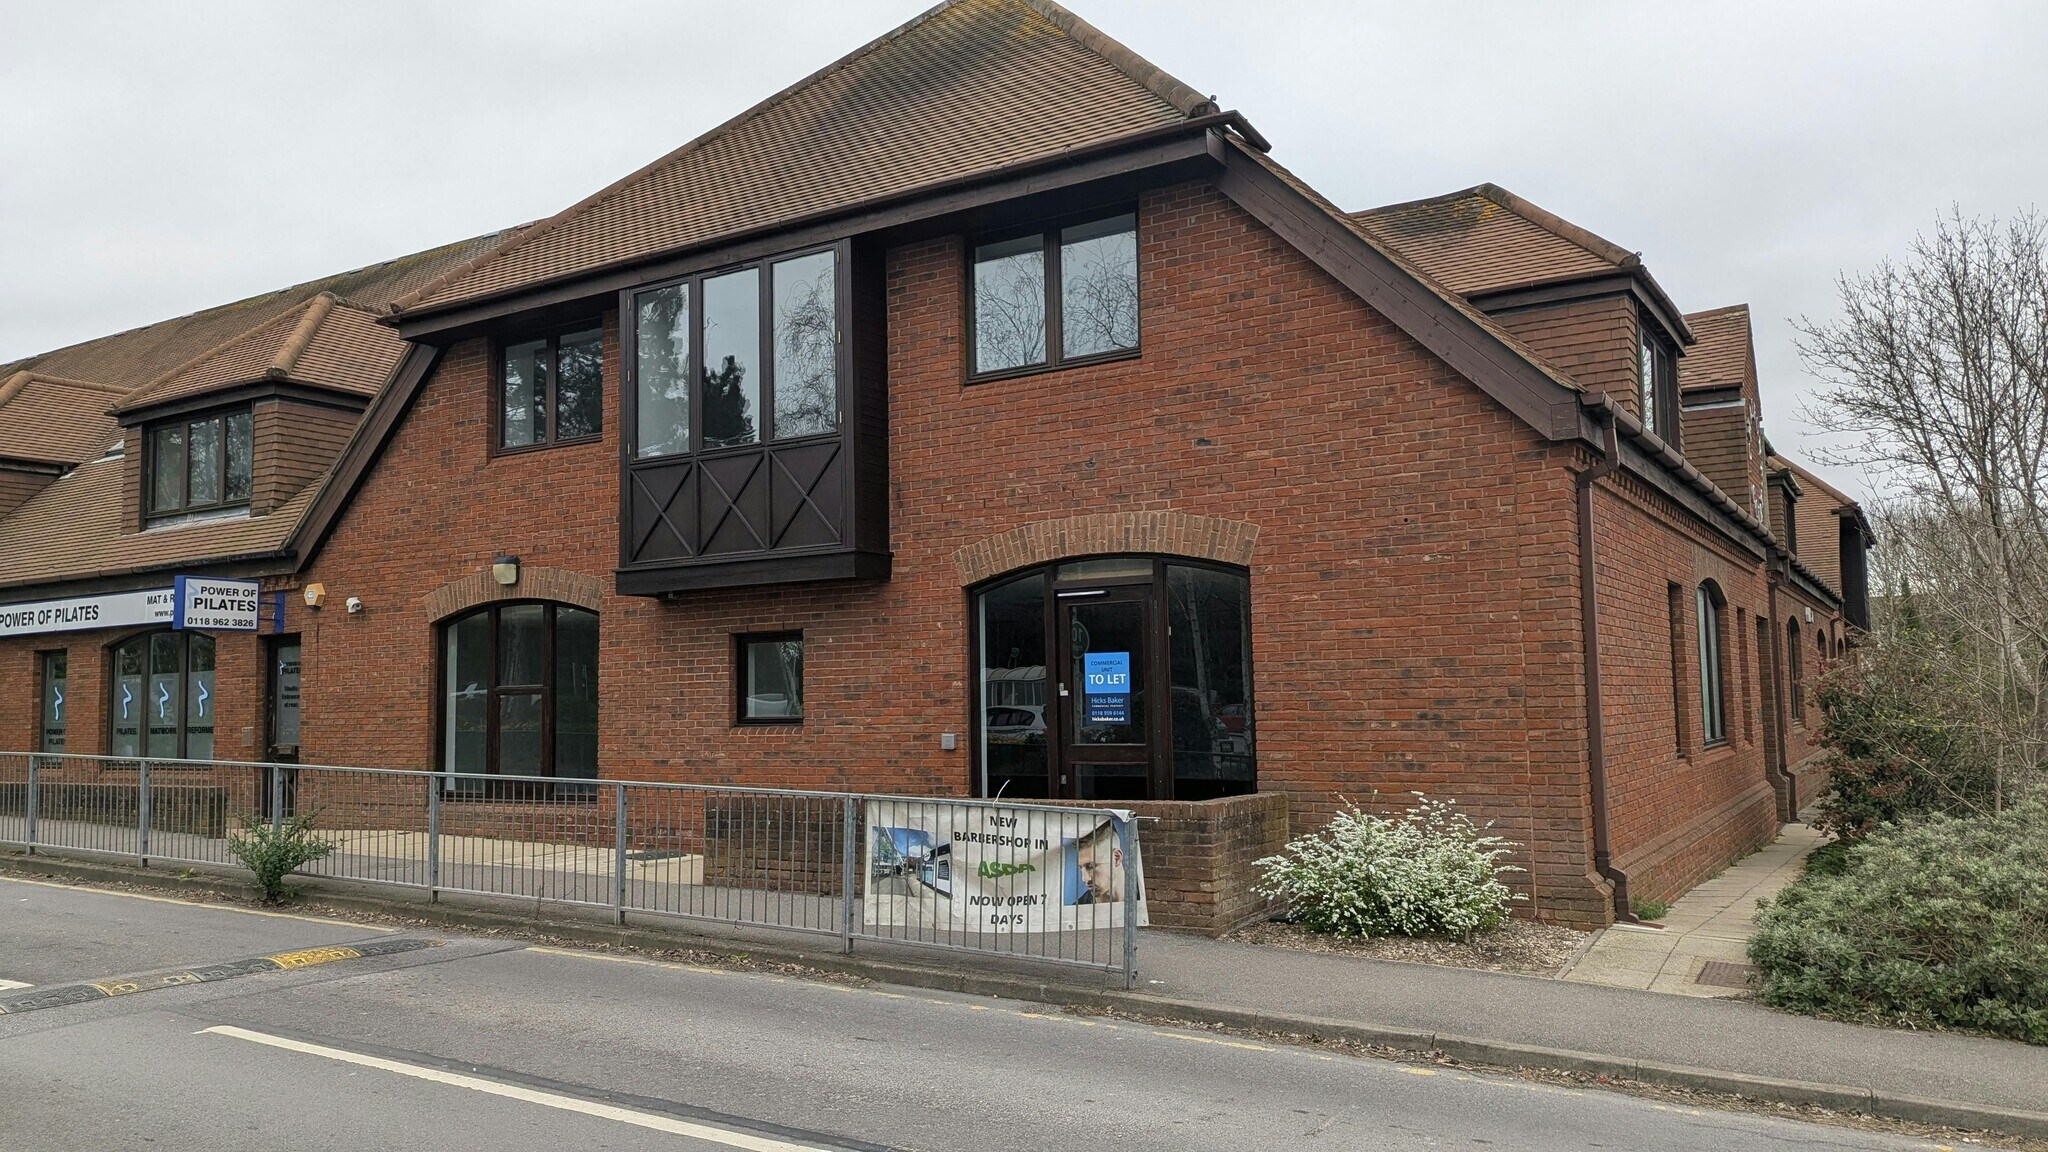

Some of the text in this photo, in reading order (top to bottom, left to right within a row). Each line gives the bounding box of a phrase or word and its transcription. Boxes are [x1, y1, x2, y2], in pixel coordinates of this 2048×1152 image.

[201, 586, 257, 598] POWER OF
[147, 595, 162, 605] MAT
[163, 594, 168, 604] &
[194, 597, 256, 612] PILATES
[38, 609, 52, 625] OF
[55, 605, 99, 624] PILATES
[187, 617, 254, 627] 0118 962 3826
[1089, 673, 1126, 684] TO LET
[1107, 696, 1124, 704] Baker
[116, 727, 137, 735] PILATES
[990, 816, 1017, 828] NEW
[954, 831, 1048, 850] BARBERSHOP IN
[978, 861, 1036, 878] ASDA
[970, 894, 1047, 907] NOW OPEN 7
[990, 914, 1023, 925] DAYS
